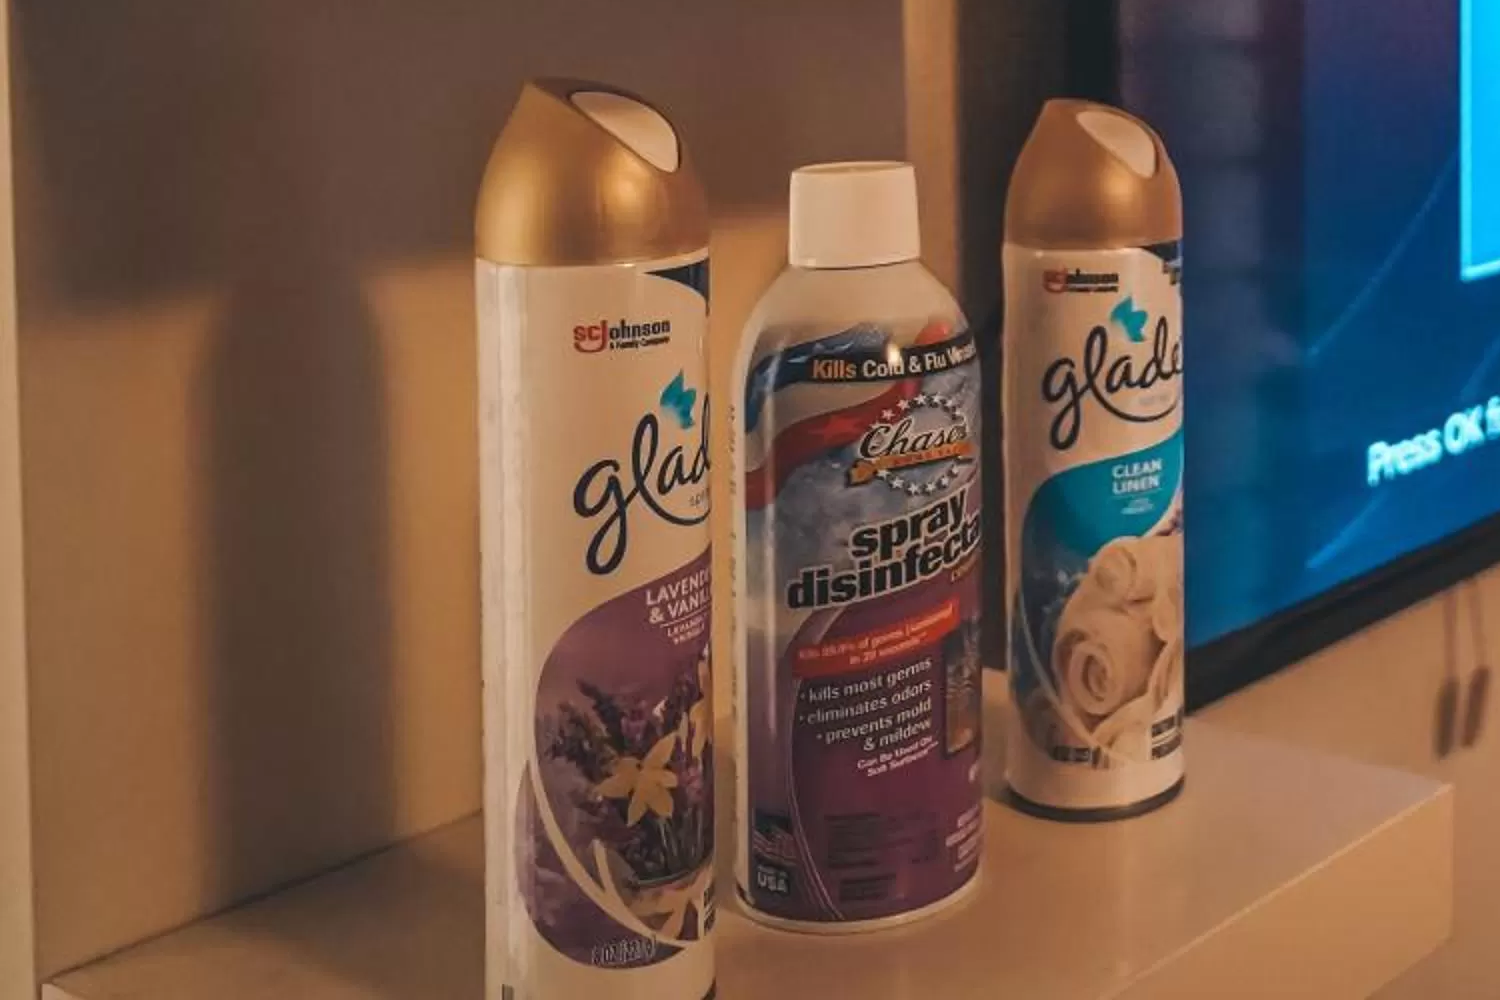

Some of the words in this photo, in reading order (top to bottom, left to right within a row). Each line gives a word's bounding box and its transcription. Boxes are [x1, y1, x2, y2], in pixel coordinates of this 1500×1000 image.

[813, 358, 857, 379] Kills
[908, 355, 922, 373] &
[924, 349, 947, 371] Flu
[1367, 428, 1443, 487] Press
[1443, 402, 1486, 455] OK
[572, 390, 711, 576] glad
[1112, 457, 1163, 479] CLEAN
[1112, 474, 1161, 495] LINEN
[850, 486, 969, 562] spray
[786, 513, 981, 609] disinfecta
[645, 567, 711, 606] LAVEND
[648, 606, 665, 624] &
[809, 684, 841, 702] kills
[843, 674, 883, 697] most
[887, 657, 932, 688] germs
[807, 697, 888, 725] eliminates
[891, 680, 933, 708] odors
[826, 713, 894, 746] prevents
[896, 697, 932, 722] mold
[863, 736, 876, 752] &
[879, 719, 933, 747] mildew
